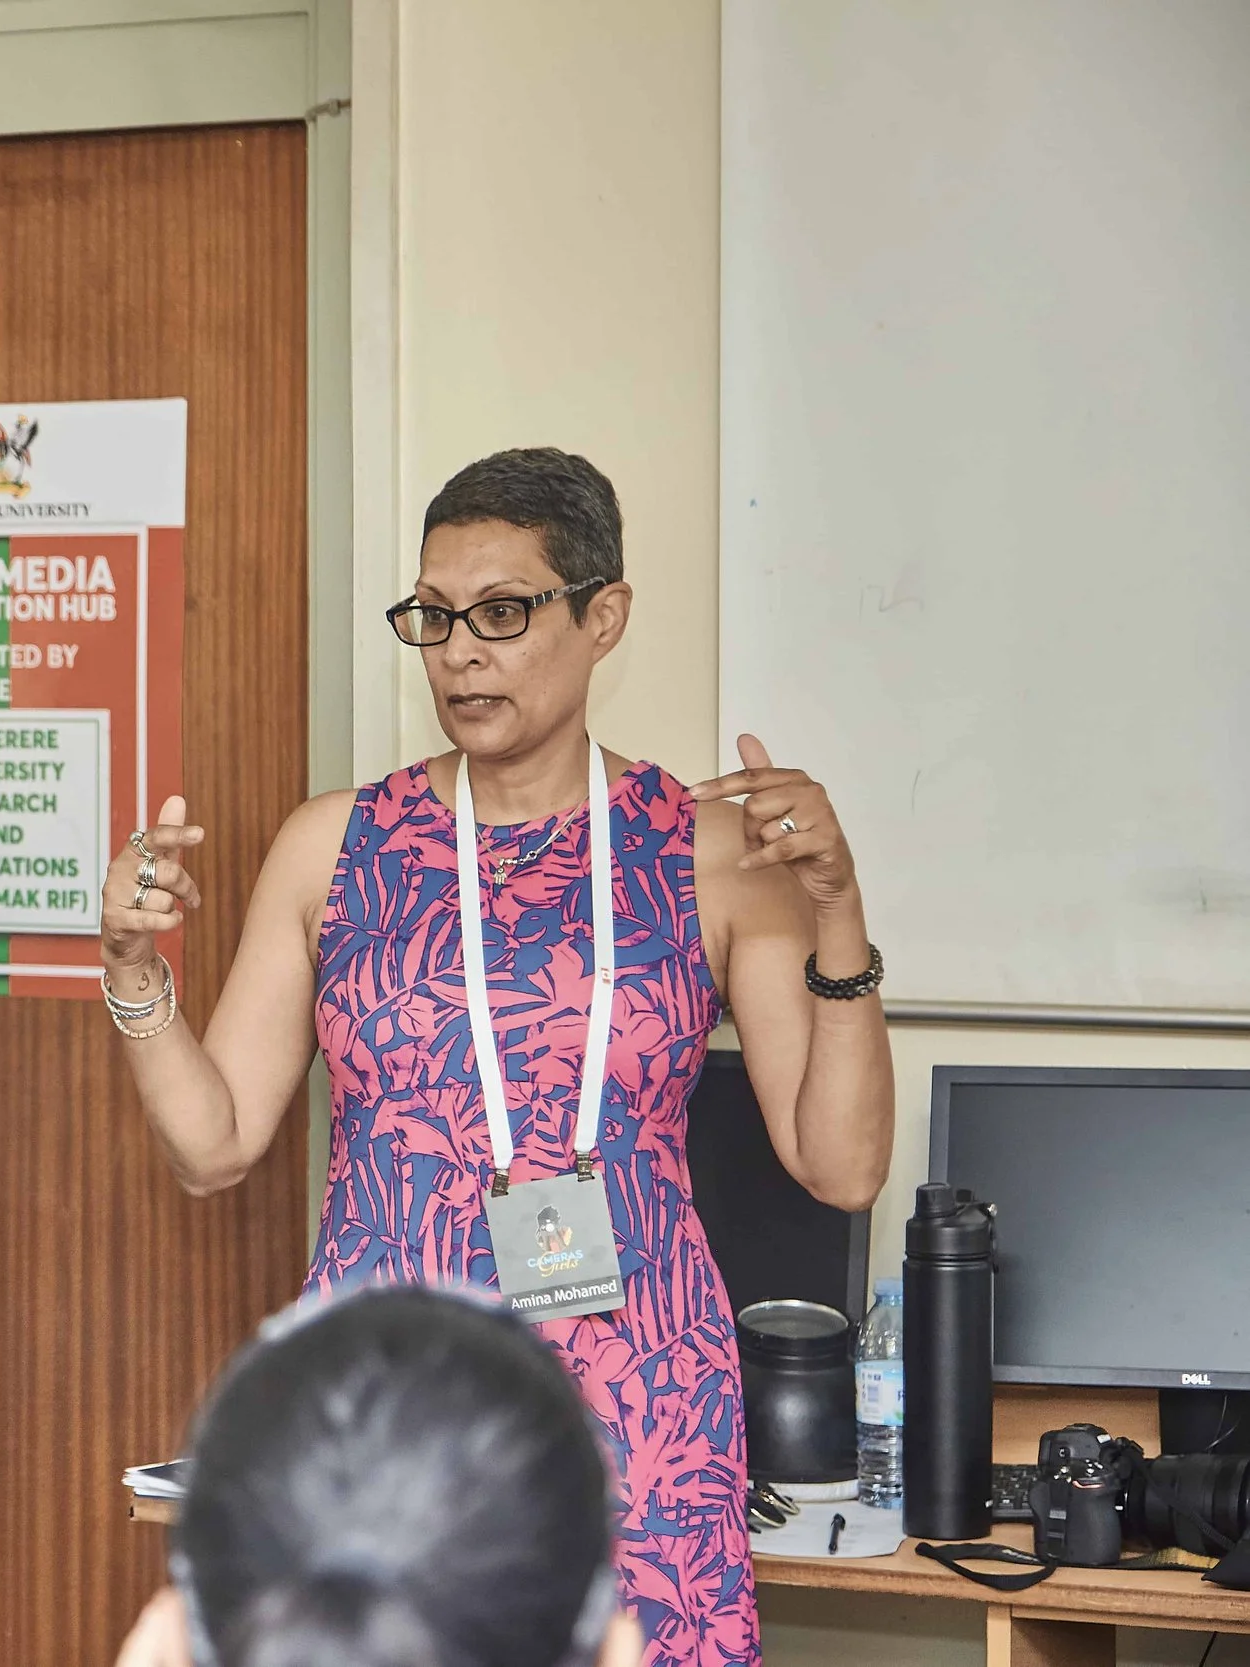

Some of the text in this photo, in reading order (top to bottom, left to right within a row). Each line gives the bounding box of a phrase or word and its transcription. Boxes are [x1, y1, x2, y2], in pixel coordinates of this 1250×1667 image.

[60, 595, 116, 620] HUB
[48, 644, 78, 668] BY
[48, 892, 87, 912] RIF)
[527, 1249, 584, 1268] CAMERAS
[538, 1251, 579, 1278] Girls
[511, 1279, 618, 1310] Amina Mohamed
[1181, 1373, 1211, 1385] DELL
